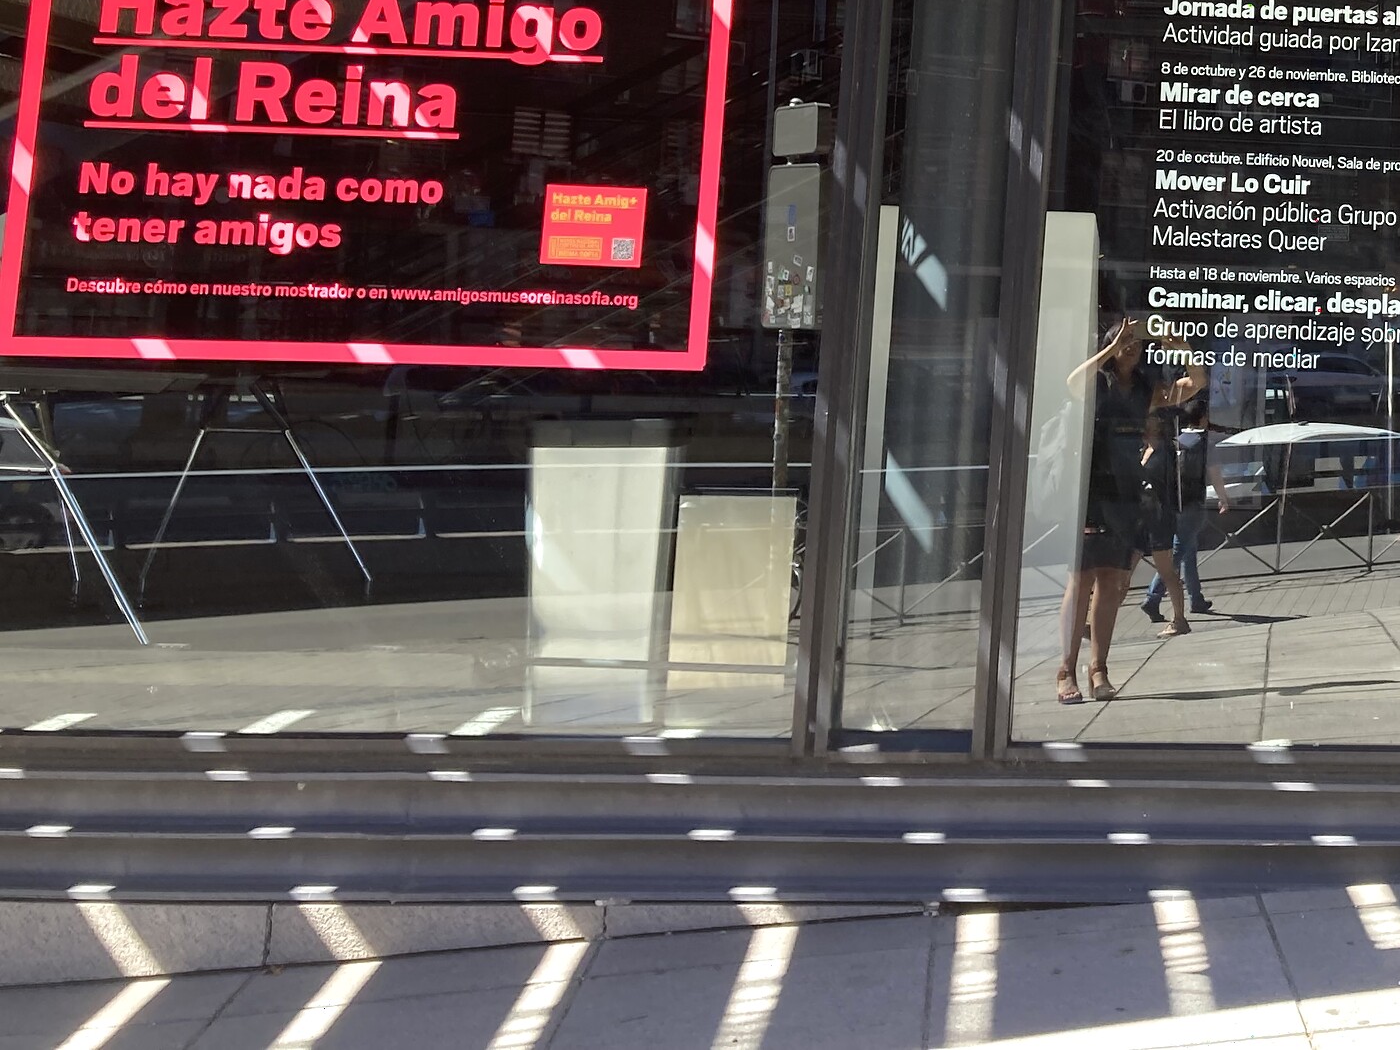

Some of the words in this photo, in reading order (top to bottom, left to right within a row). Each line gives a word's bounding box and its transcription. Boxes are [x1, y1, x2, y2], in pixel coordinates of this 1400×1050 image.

[1261, 0, 1287, 21] de
[1293, 5, 1378, 26] puertas
[89, 54, 213, 120] del
[235, 61, 457, 129] Reina
[1161, 82, 1220, 104] Mirar
[1225, 85, 1253, 105] de
[1258, 91, 1319, 108] cerca
[1160, 110, 1176, 130] El
[1184, 110, 1223, 132] libro
[1230, 112, 1253, 133] de
[1260, 114, 1321, 135] artista
[79, 162, 134, 195] No
[146, 162, 219, 206] hay
[228, 167, 325, 201] nada
[337, 177, 443, 204] como
[1156, 169, 1226, 192] Mover
[1231, 172, 1258, 193] Lo
[1264, 174, 1310, 195] Cuir
[552, 192, 592, 205] Hazte
[550, 209, 572, 221] del
[574, 210, 612, 222] Reina
[72, 211, 185, 244] tener
[194, 212, 341, 255] amigos
[67, 277, 141, 294] Descubre
[144, 280, 187, 295] cómo
[190, 284, 209, 295] en
[213, 282, 272, 297] nuestro
[275, 283, 354, 299] mostrador
[356, 287, 366, 299] o
[369, 288, 387, 300] en
[391, 288, 638, 310] www.amigosmuseoreinasofia.org
[1149, 286, 1248, 314] Caminar,
[1255, 289, 1320, 316] clicar,
